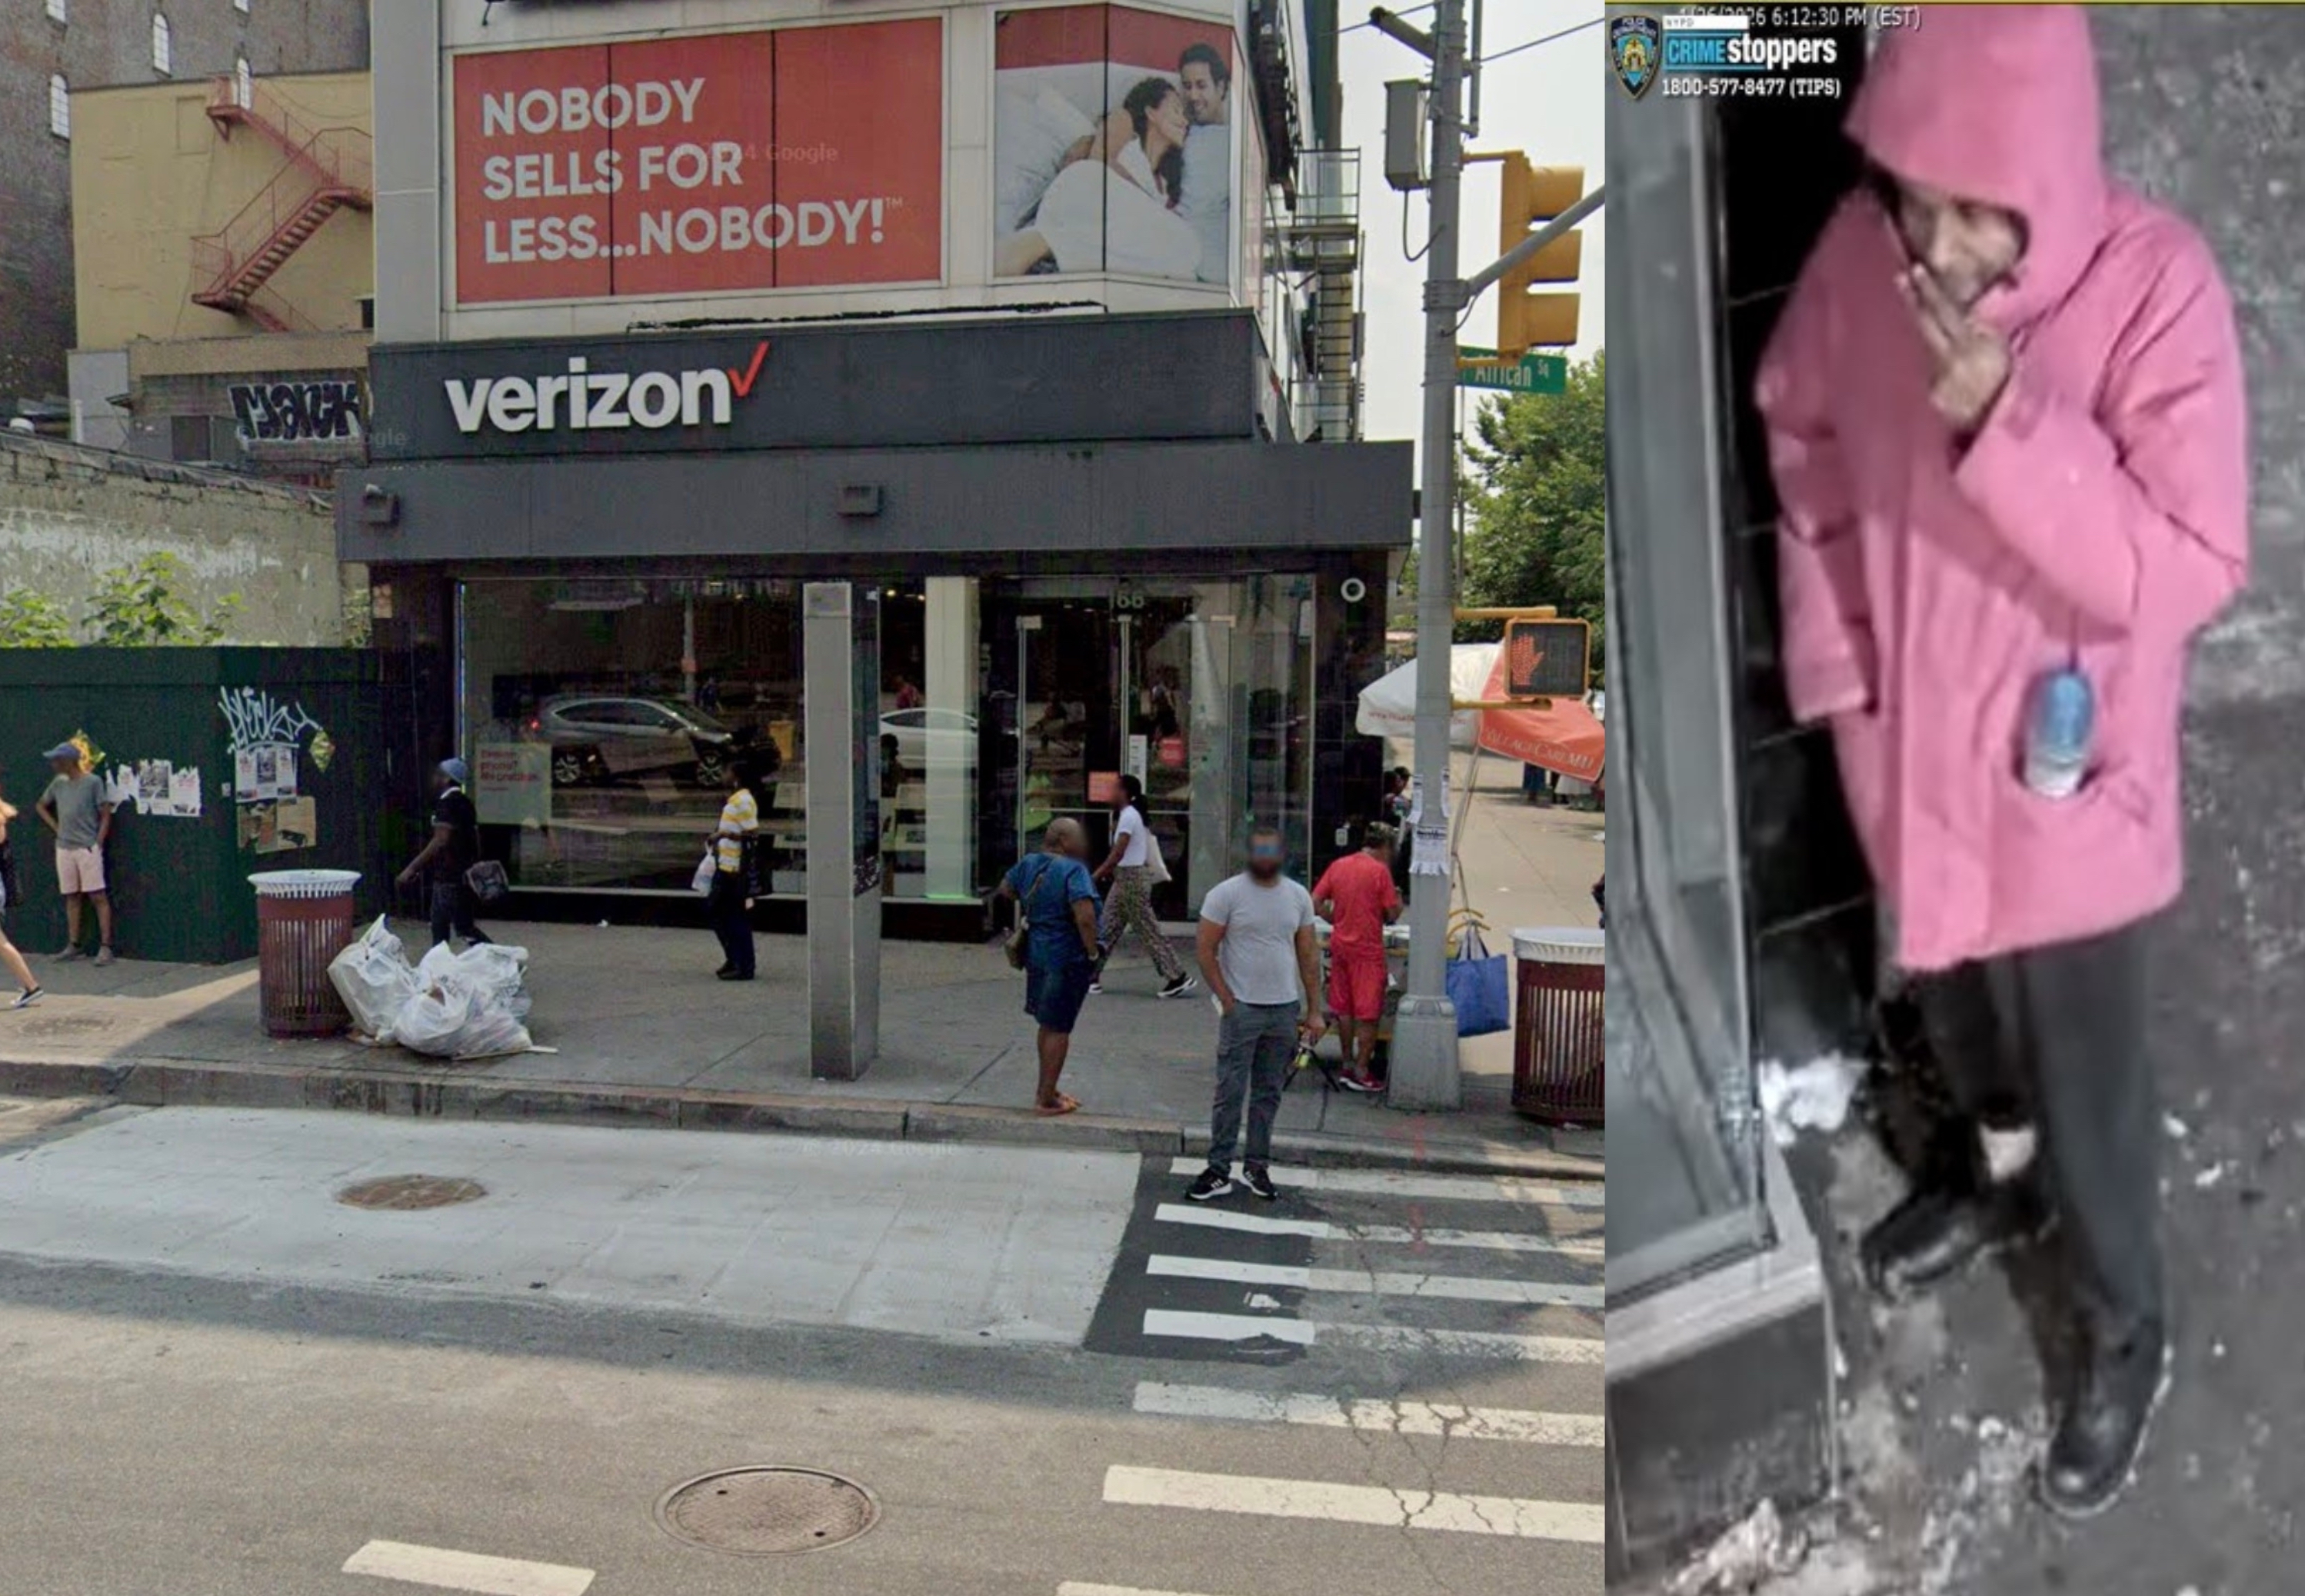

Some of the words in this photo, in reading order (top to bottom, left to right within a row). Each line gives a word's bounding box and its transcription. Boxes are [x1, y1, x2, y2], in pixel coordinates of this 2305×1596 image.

[482, 78, 705, 137] NOBODY
[483, 149, 624, 201] SELLS
[638, 142, 744, 191] FOR
[444, 357, 732, 432] verizon
